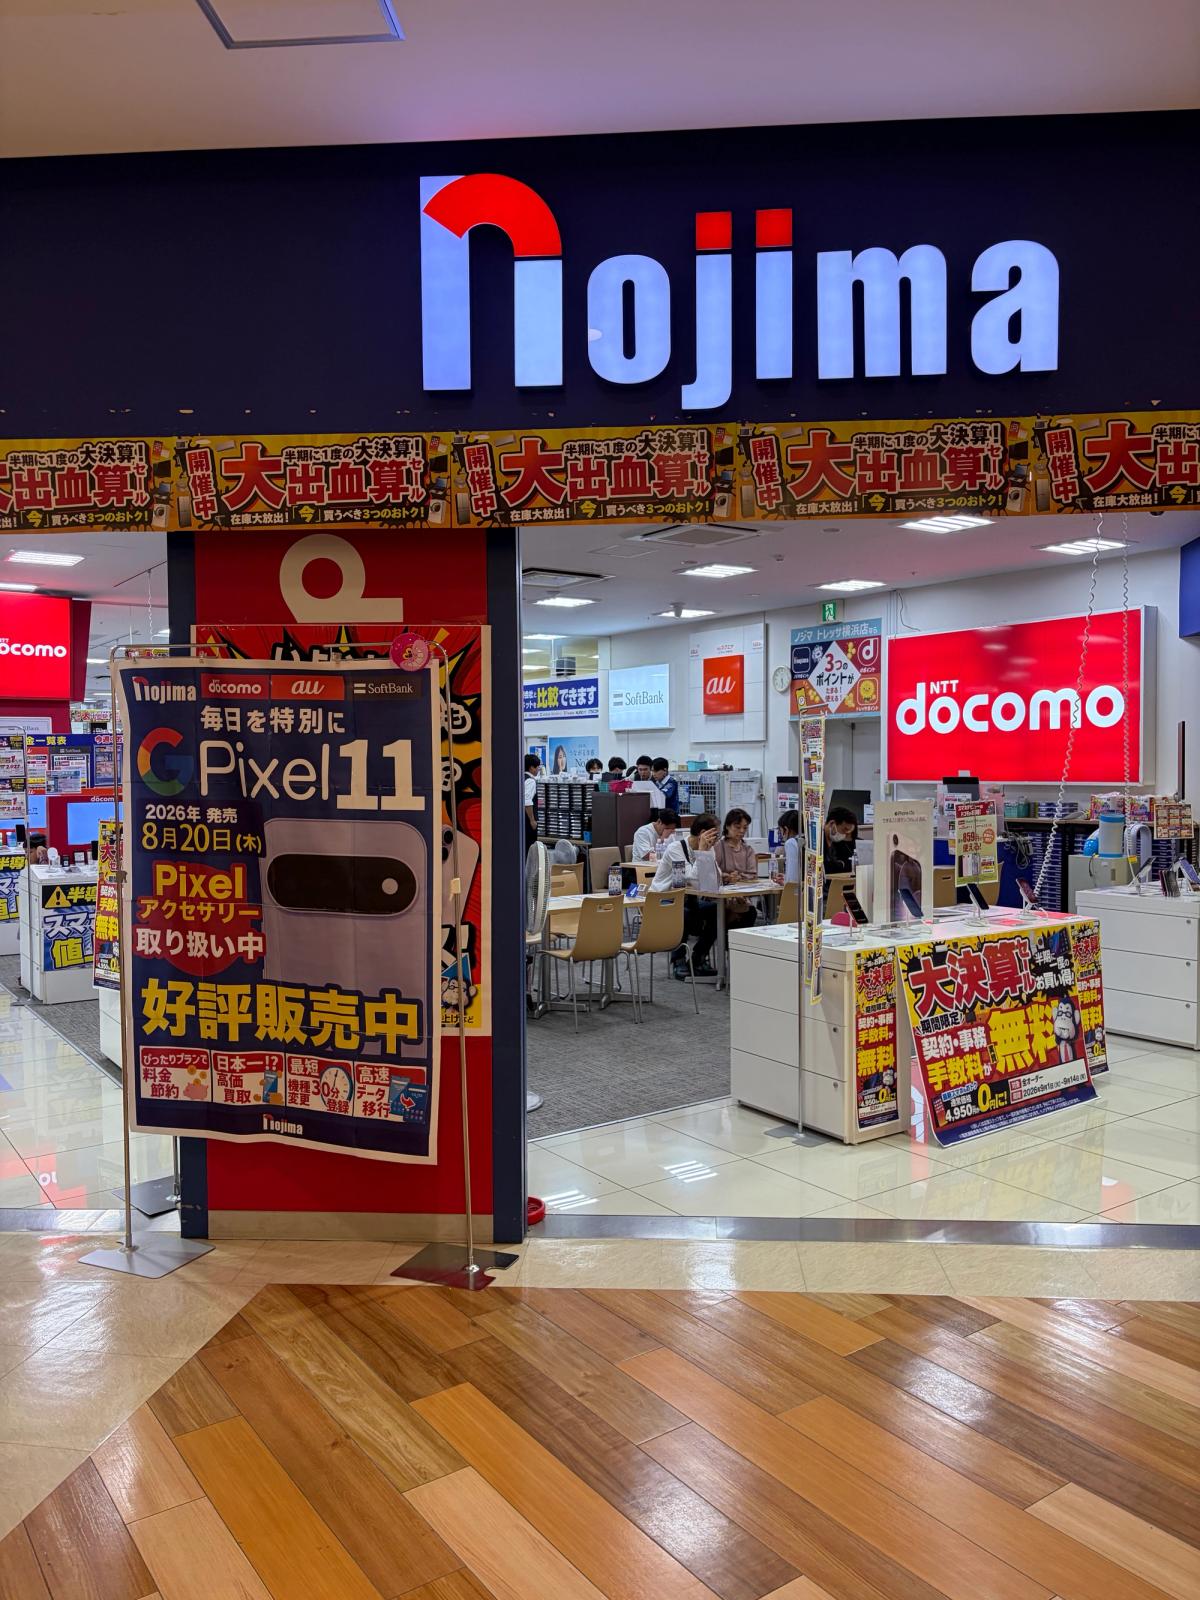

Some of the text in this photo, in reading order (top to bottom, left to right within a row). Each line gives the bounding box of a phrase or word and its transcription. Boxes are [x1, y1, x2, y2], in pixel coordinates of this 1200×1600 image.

[420, 173, 1059, 410] nojima
[750, 437, 782, 509] 開催中
[1046, 429, 1079, 503] 開催中
[186, 449, 217, 520] 開催中
[465, 444, 496, 516] 開催中
[0, 517, 17, 528] 出!
[824, 653, 848, 672] 3つの
[208, 678, 262, 695] docomo
[291, 679, 325, 695] au
[368, 682, 413, 694] SoftBank
[706, 676, 736, 695] au
[816, 672, 855, 686] ポイントが
[929, 680, 959, 694] NTT
[132, 676, 197, 704] nojima
[537, 686, 597, 709] 比較できます
[625, 690, 664, 706] SoftBank
[895, 682, 1125, 735] docomo
[200, 706, 345, 734] 毎日を特別に
[156, 864, 244, 899] Pixel
[630, 888, 638, 897] 4
[140, 899, 259, 923] アクセサリー
[136, 928, 264, 960] 取り扱い中
[141, 978, 419, 1054] 好評販売中
[290, 1058, 319, 1076] 最短
[857, 1045, 895, 1077] 無料
[143, 1068, 172, 1083] 料金
[217, 1073, 243, 1088] 高価
[359, 1066, 390, 1084] 高速
[150, 1084, 179, 1099] 節約
[224, 1089, 251, 1104] 買取
[357, 1085, 385, 1102] データ
[327, 1098, 349, 1114] 登録
[362, 1101, 391, 1118] 移行
[262, 1113, 303, 1135] nojima
